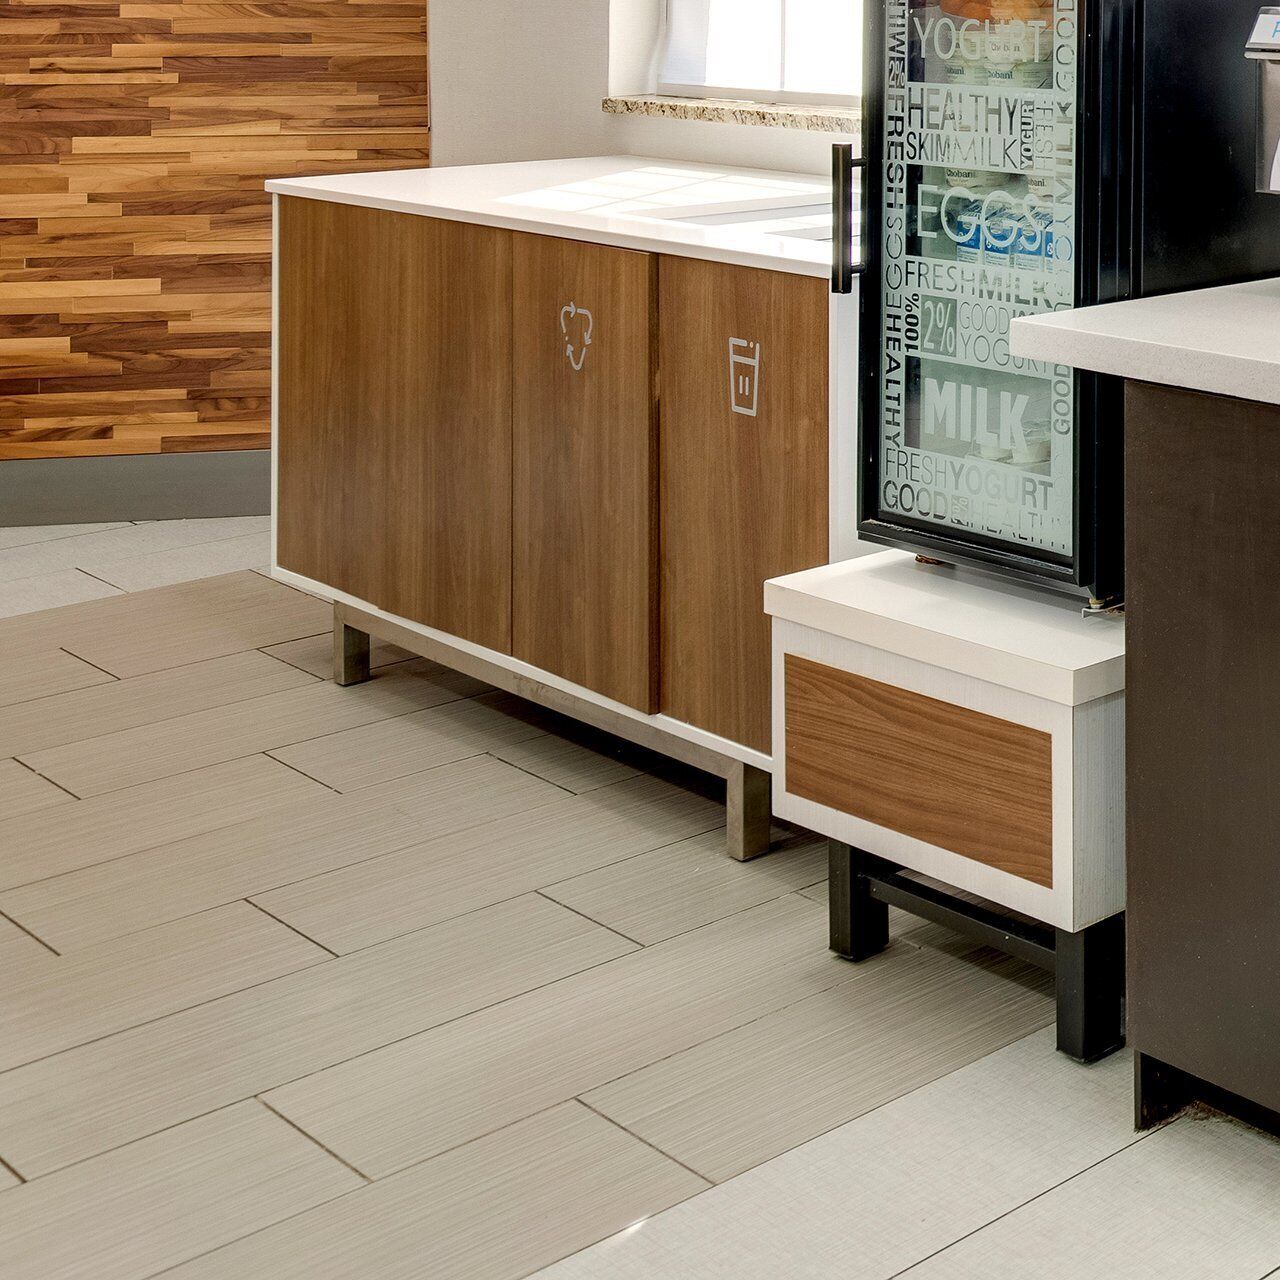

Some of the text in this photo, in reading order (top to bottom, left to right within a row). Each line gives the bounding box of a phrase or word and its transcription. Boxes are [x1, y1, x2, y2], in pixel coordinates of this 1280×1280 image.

[913, 17, 1047, 63] YOGURT
[888, 58, 905, 87] 2%
[908, 87, 1018, 136] HEALTHY
[886, 93, 905, 210] FRESH
[1055, 101, 1074, 206] MILK
[917, 183, 1042, 252] EGGS
[885, 216, 903, 308] EGGS
[905, 260, 1053, 310] FRESH MILK
[904, 292, 920, 353] 100%
[923, 300, 955, 354] 2%
[959, 301, 1010, 336] GOOD
[885, 313, 902, 449] HEALTHY
[1053, 363, 1071, 436] GOOD
[924, 377, 1030, 452] MILK
[882, 480, 947, 521] GOOD
[885, 447, 947, 489] FRESH
[949, 460, 1053, 511] YOGURT
